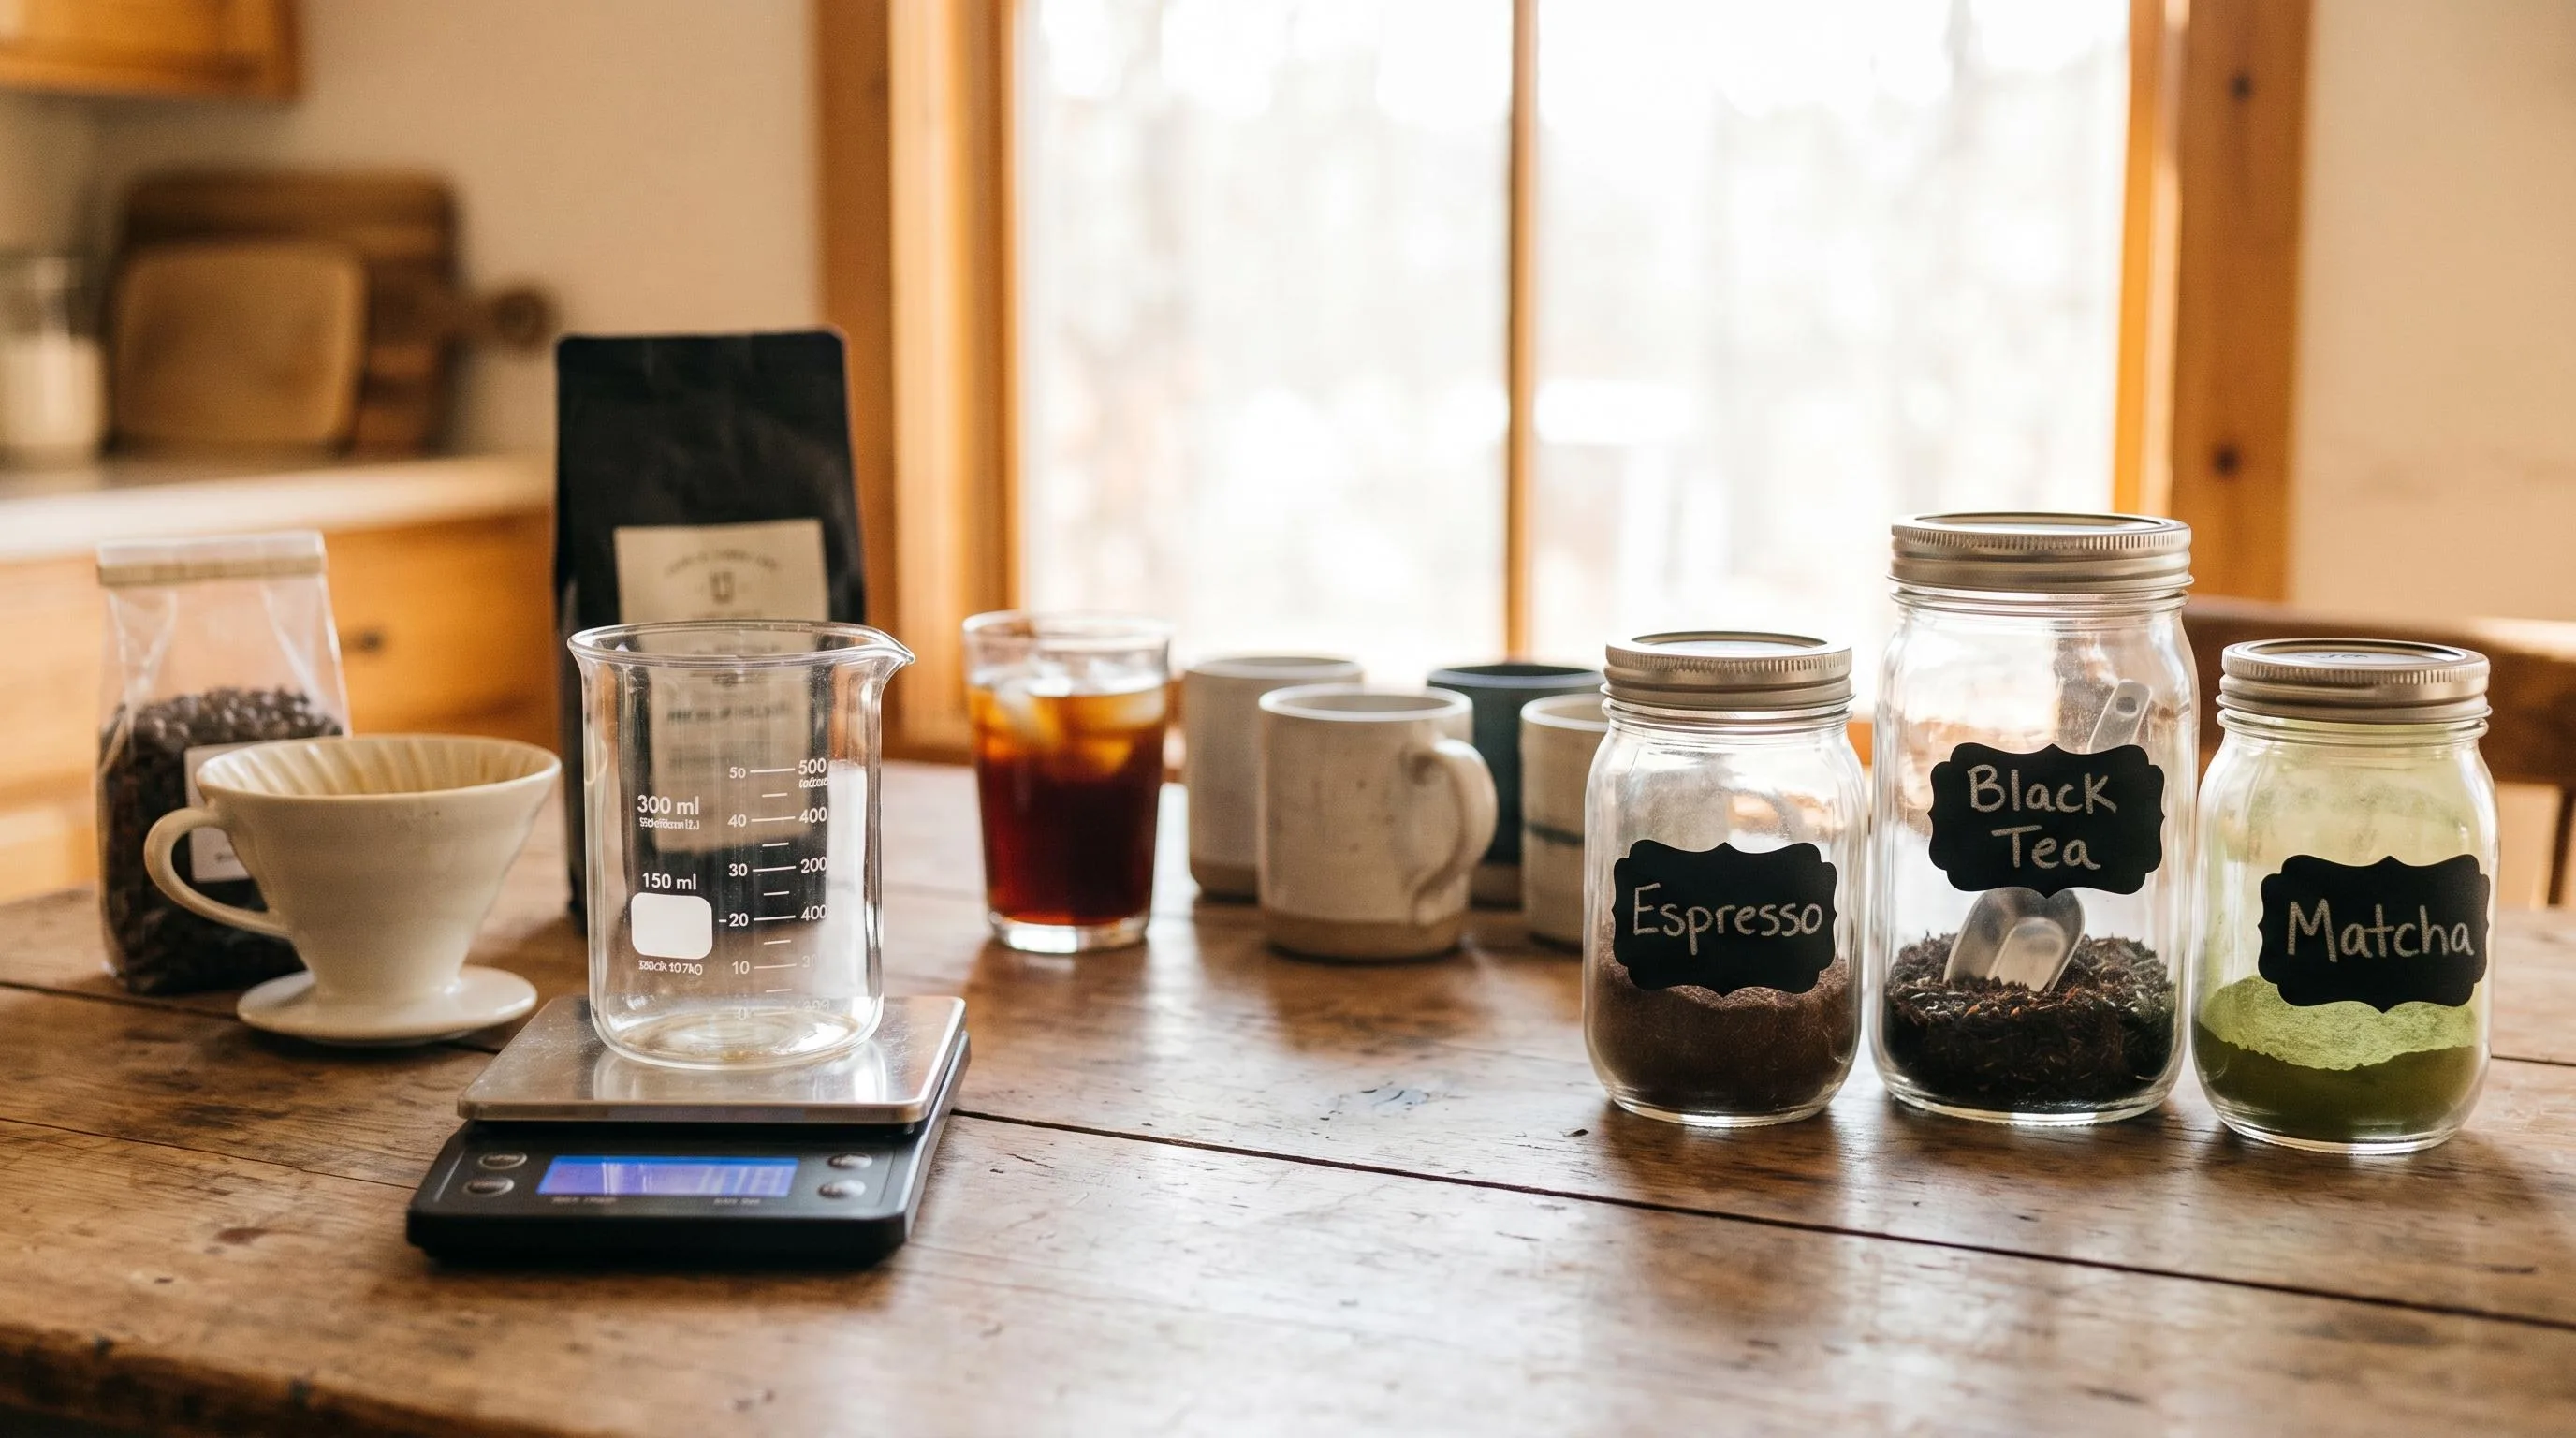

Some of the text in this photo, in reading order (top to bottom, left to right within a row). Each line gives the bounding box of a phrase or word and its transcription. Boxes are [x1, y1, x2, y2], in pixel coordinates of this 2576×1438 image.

[729, 767, 746, 779] 50
[798, 757, 827, 775] 500
[1968, 764, 2117, 814] Black
[637, 794, 699, 815] 300 ml
[727, 814, 747, 828] 40
[798, 807, 827, 824] 400
[1991, 825, 2101, 870] Tea
[729, 863, 748, 877] 30
[800, 857, 827, 873] 200
[642, 873, 697, 890] 150 ml
[800, 904, 827, 921] 400
[1633, 882, 1823, 956] Espresso
[2287, 898, 2475, 962] Matcha
[732, 961, 750, 975] 10
